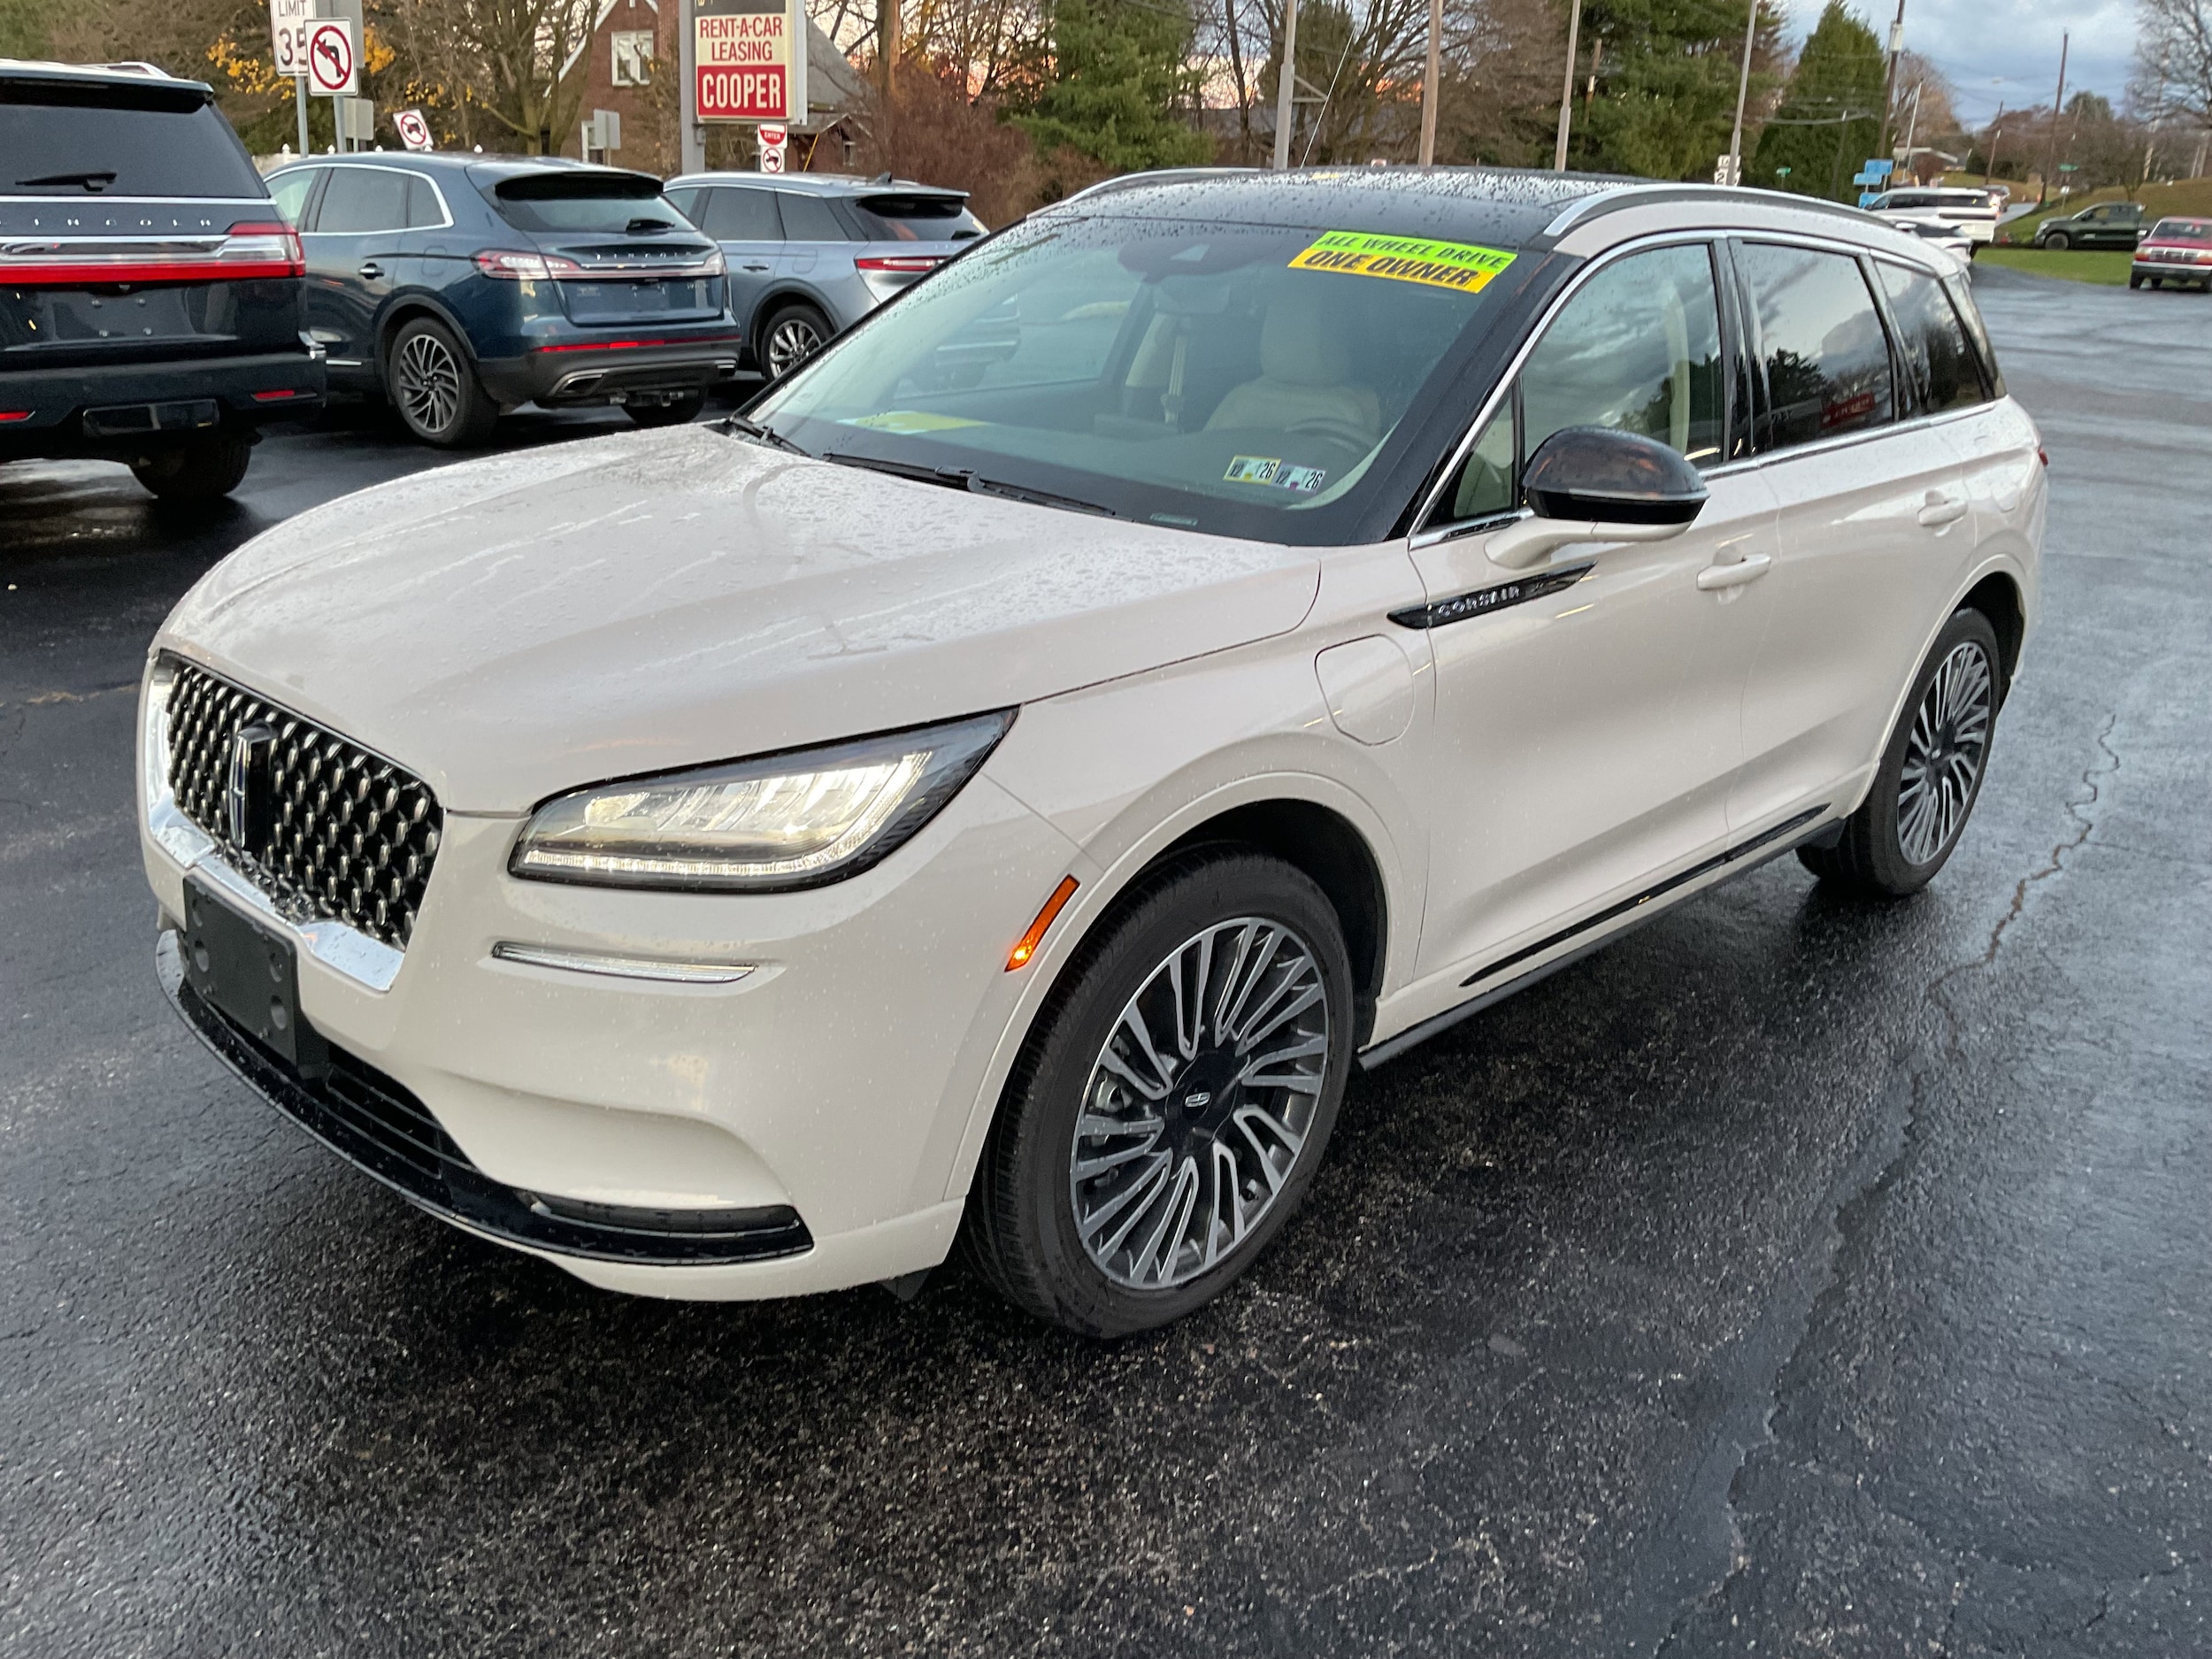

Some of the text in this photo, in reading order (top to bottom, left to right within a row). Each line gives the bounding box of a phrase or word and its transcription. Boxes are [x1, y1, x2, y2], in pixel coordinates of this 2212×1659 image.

[279, 0, 306, 17] LIMIT
[700, 16, 783, 38] RENT-A-CAR
[279, 27, 307, 66] 35
[711, 41, 773, 61] LEASING
[703, 73, 781, 109] COOPER
[1317, 234, 1510, 270] ALL WHEEL DRIVE
[1303, 250, 1481, 288] ONE OWNER
[1259, 460, 1276, 480] 26
[1304, 471, 1324, 489] 26
